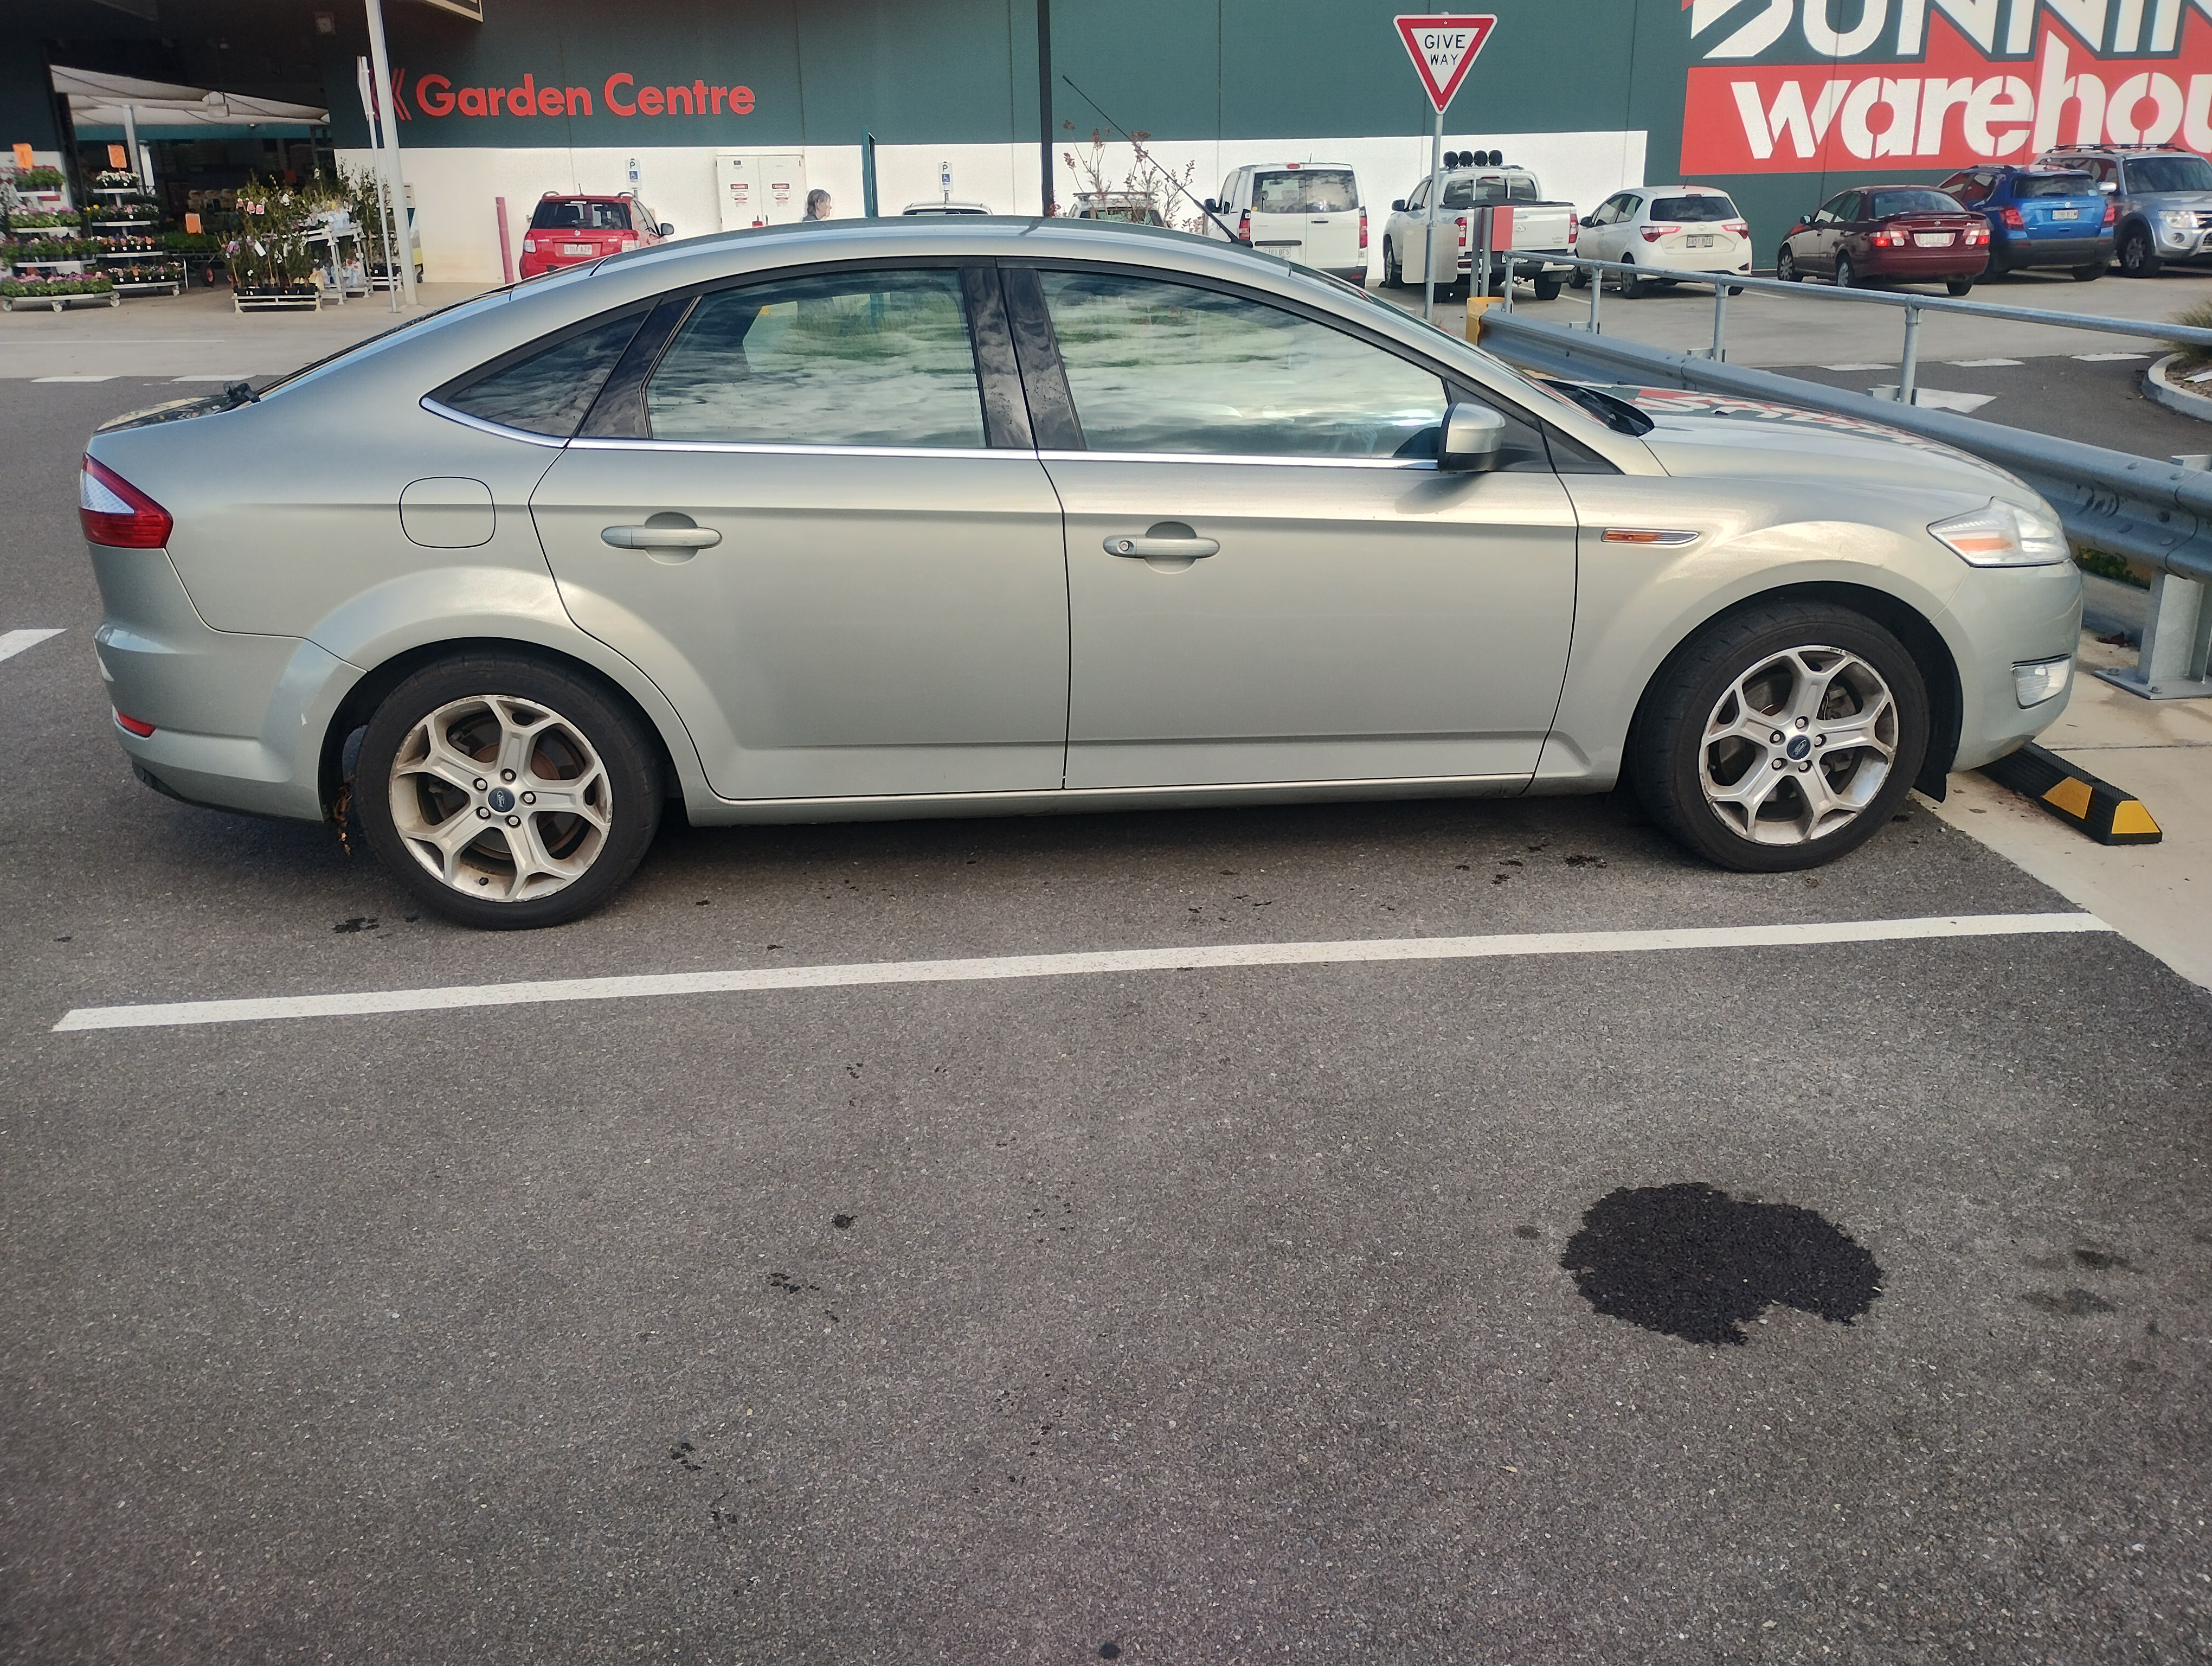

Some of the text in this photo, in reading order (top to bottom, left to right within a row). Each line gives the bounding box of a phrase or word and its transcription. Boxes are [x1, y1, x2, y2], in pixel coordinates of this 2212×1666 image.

[1425, 34, 1465, 49] GIVE
[1430, 54, 1458, 65] WAY
[416, 73, 756, 117] Garden Centre
